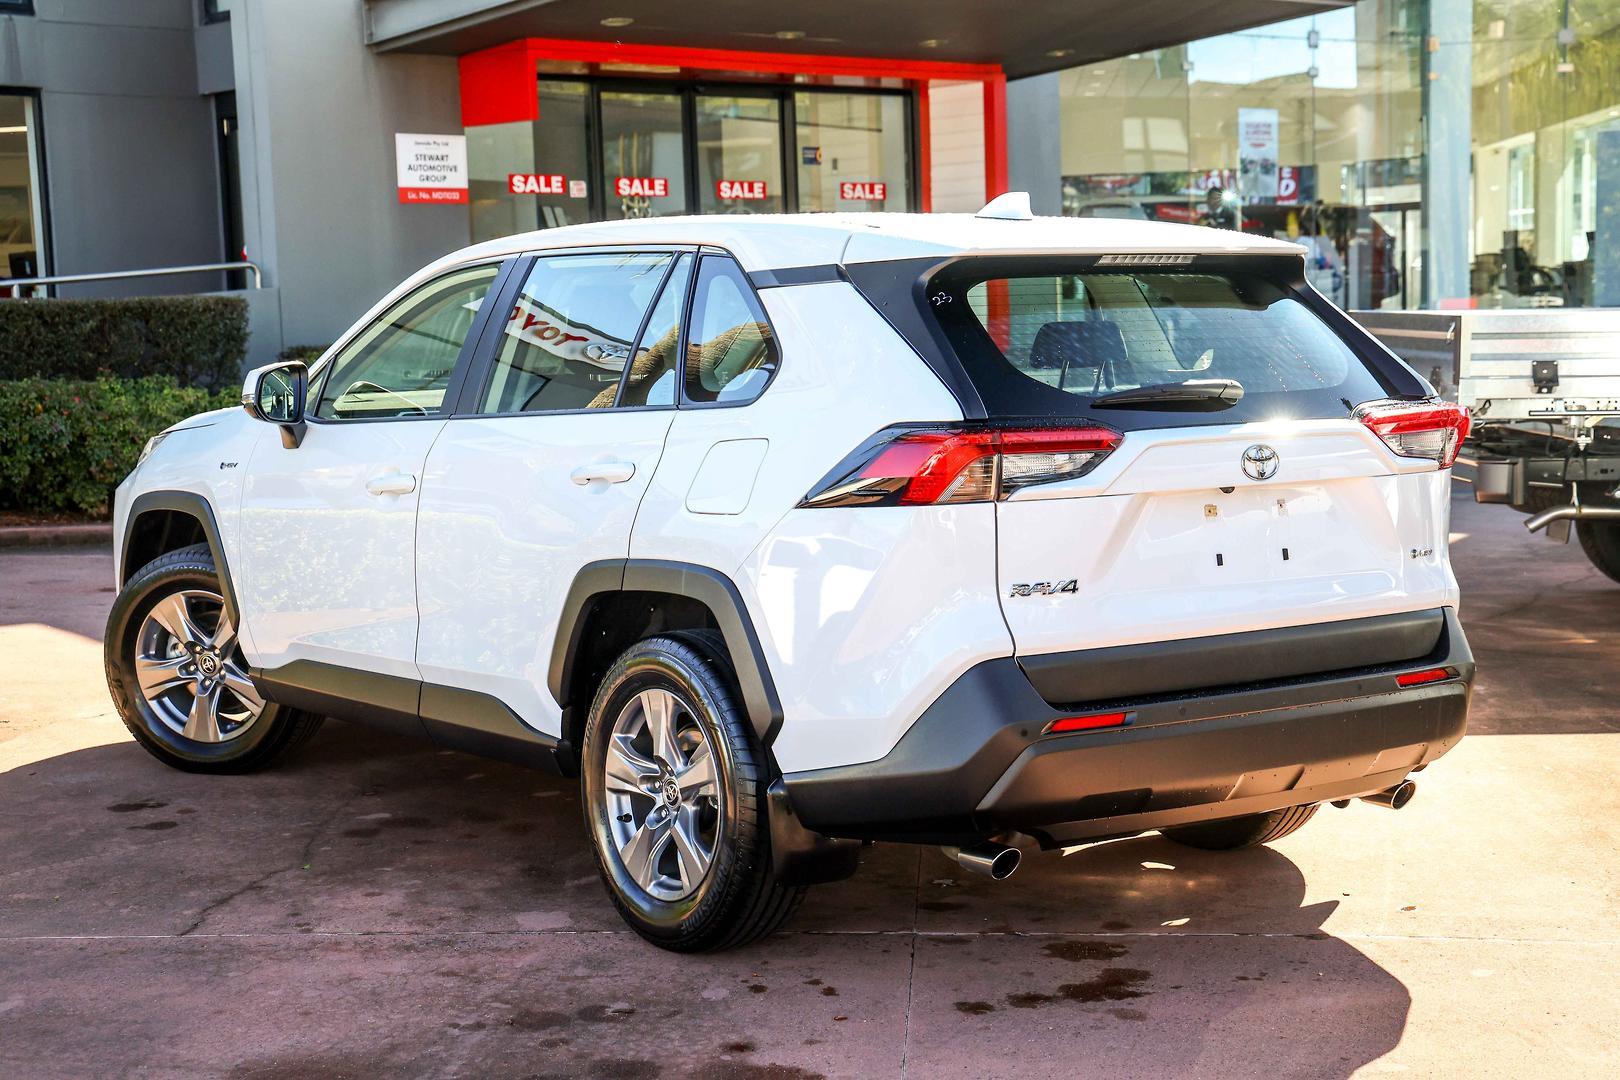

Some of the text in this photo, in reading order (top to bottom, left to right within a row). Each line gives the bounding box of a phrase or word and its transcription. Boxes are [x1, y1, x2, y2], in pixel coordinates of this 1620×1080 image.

[408, 164, 457, 172] AUTOMOTIVE
[419, 174, 447, 182] GROUP
[512, 175, 563, 193] SALE
[618, 178, 666, 196] SALE
[720, 181, 764, 198] SALE
[843, 184, 884, 199] SALE
[932, 291, 953, 306] 23
[1010, 579, 1079, 598] RAV4
